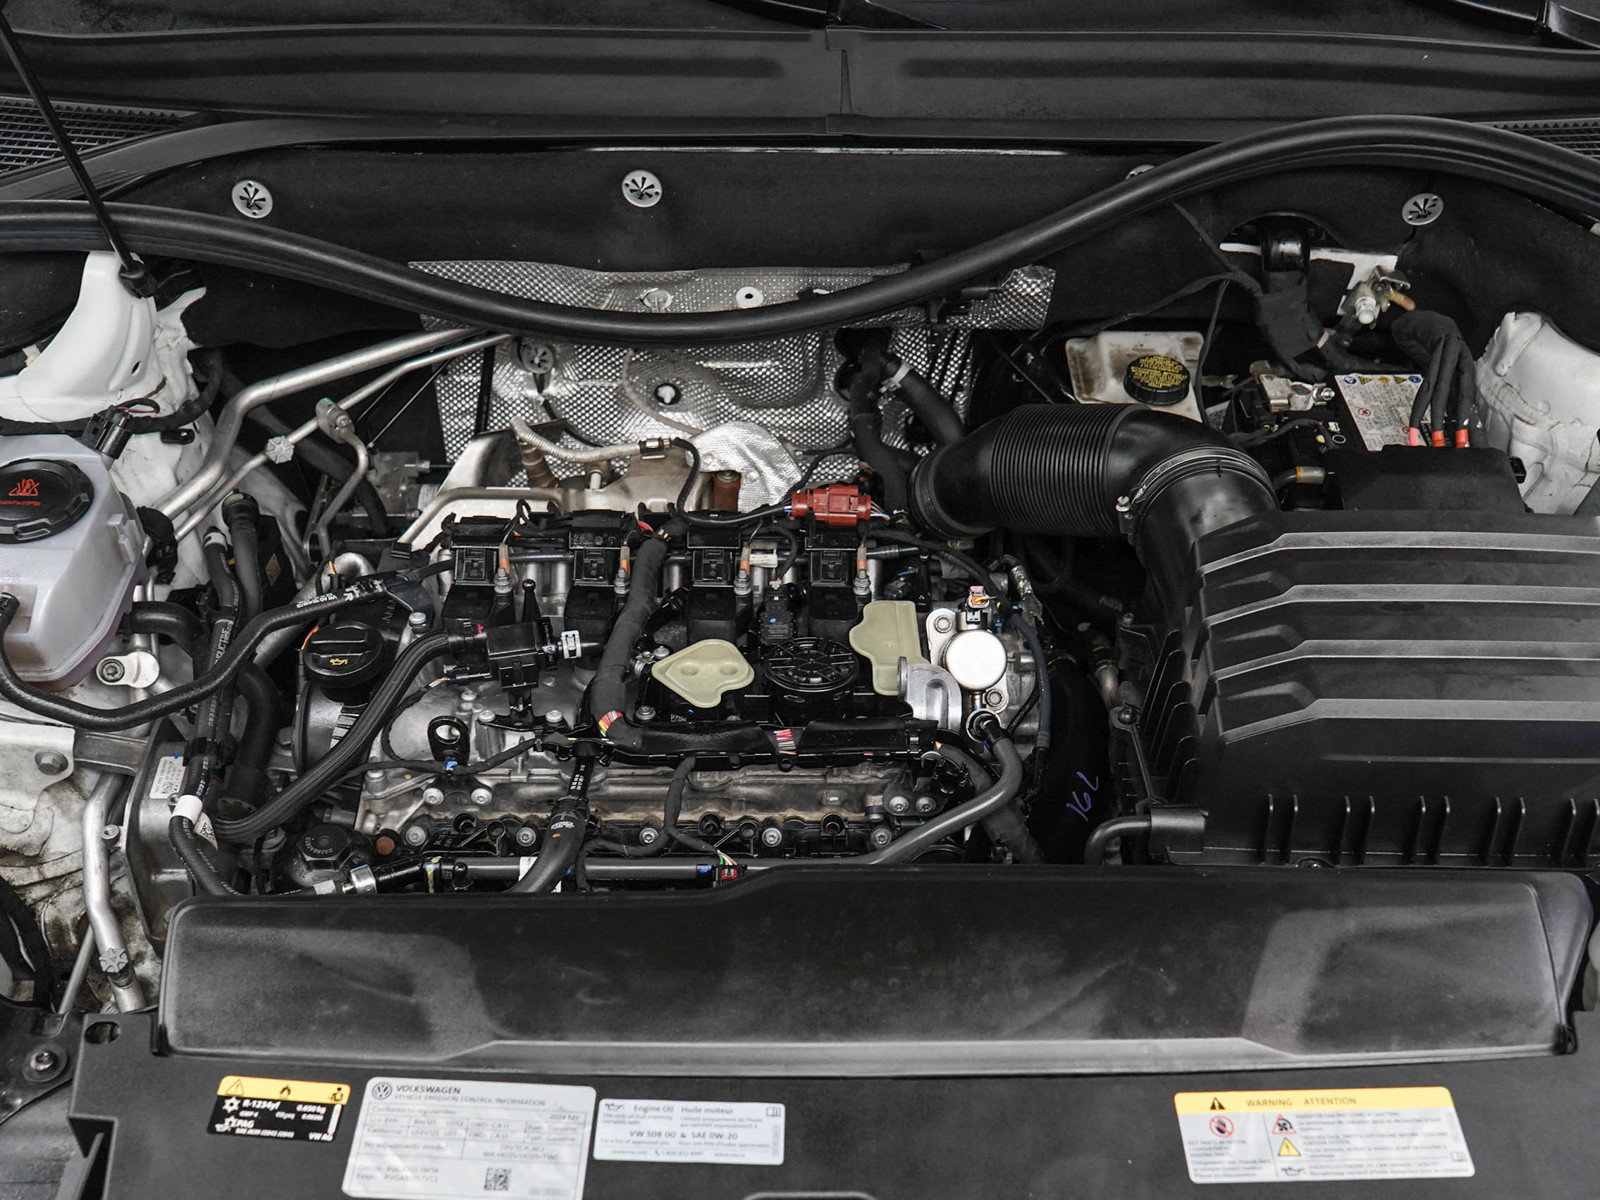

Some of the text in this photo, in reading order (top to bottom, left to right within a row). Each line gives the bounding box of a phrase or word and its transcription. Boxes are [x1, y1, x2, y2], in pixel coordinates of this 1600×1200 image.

[396, 1084, 461, 1094] VOLKSWAGEN
[1245, 1097, 1357, 1107] WARNING ATTENTION
[633, 1104, 661, 1114] Engine
[681, 1106, 734, 1115] Huile moteur
[629, 1130, 644, 1138] VW
[647, 1130, 663, 1138] 508
[664, 1131, 677, 1139] 00
[691, 1131, 706, 1140] SAE
